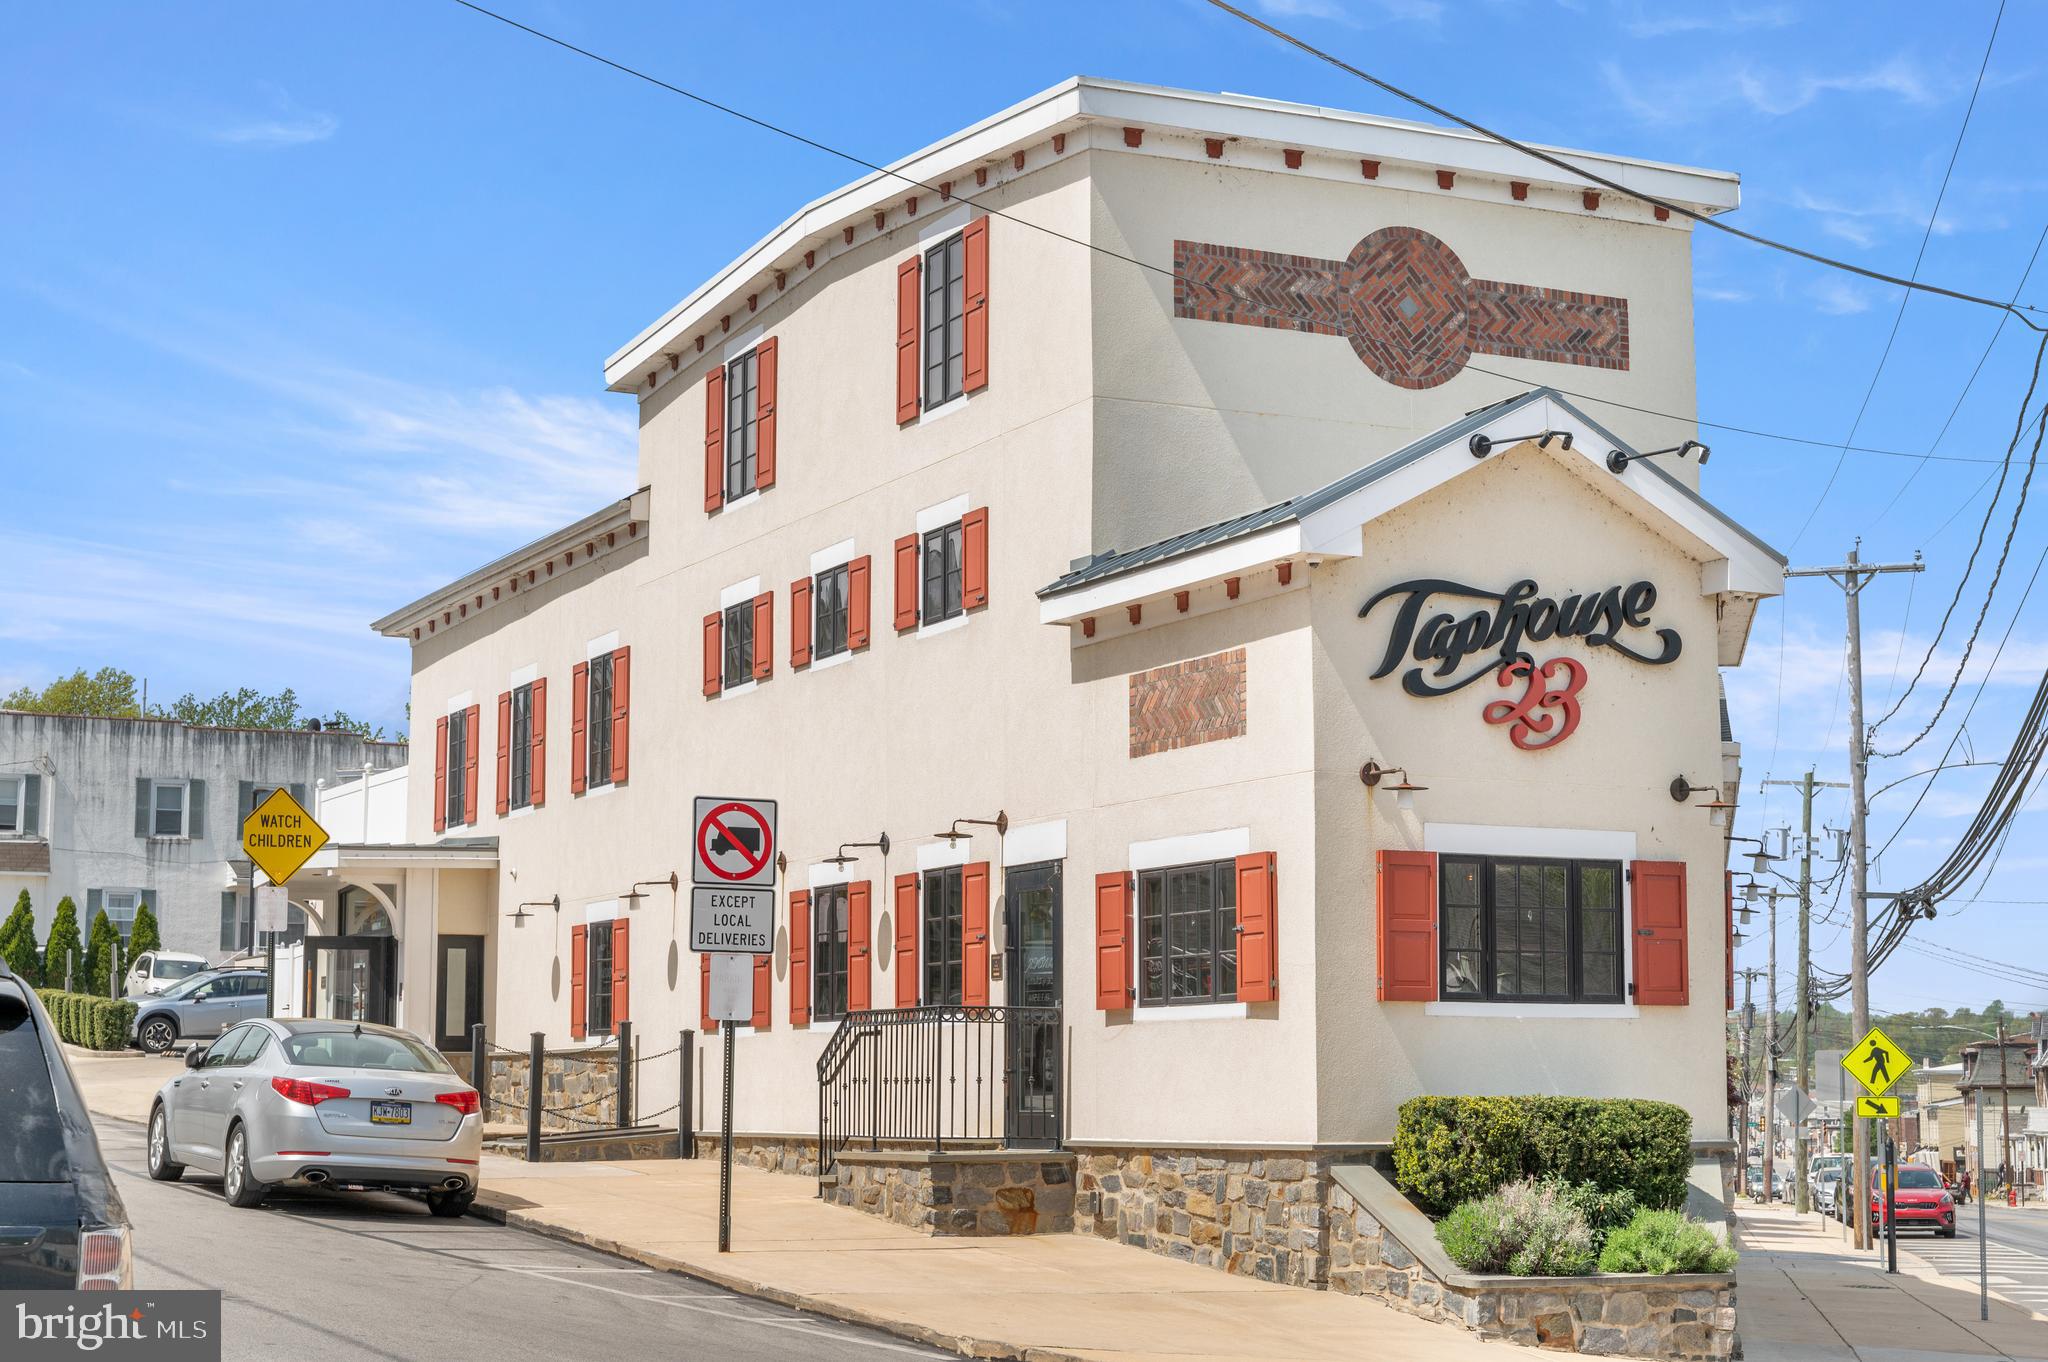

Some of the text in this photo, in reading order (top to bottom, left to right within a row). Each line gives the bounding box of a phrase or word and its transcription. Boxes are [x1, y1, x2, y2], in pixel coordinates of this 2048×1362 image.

[1358, 579, 1683, 698] Taphouse
[1482, 656, 1588, 751] 23
[260, 814, 301, 828] WATCH
[249, 834, 312, 848] CHILDREN
[711, 895, 756, 908] EXCEPT
[714, 914, 751, 927] LOCAL
[699, 932, 766, 946] DELIVERIES
